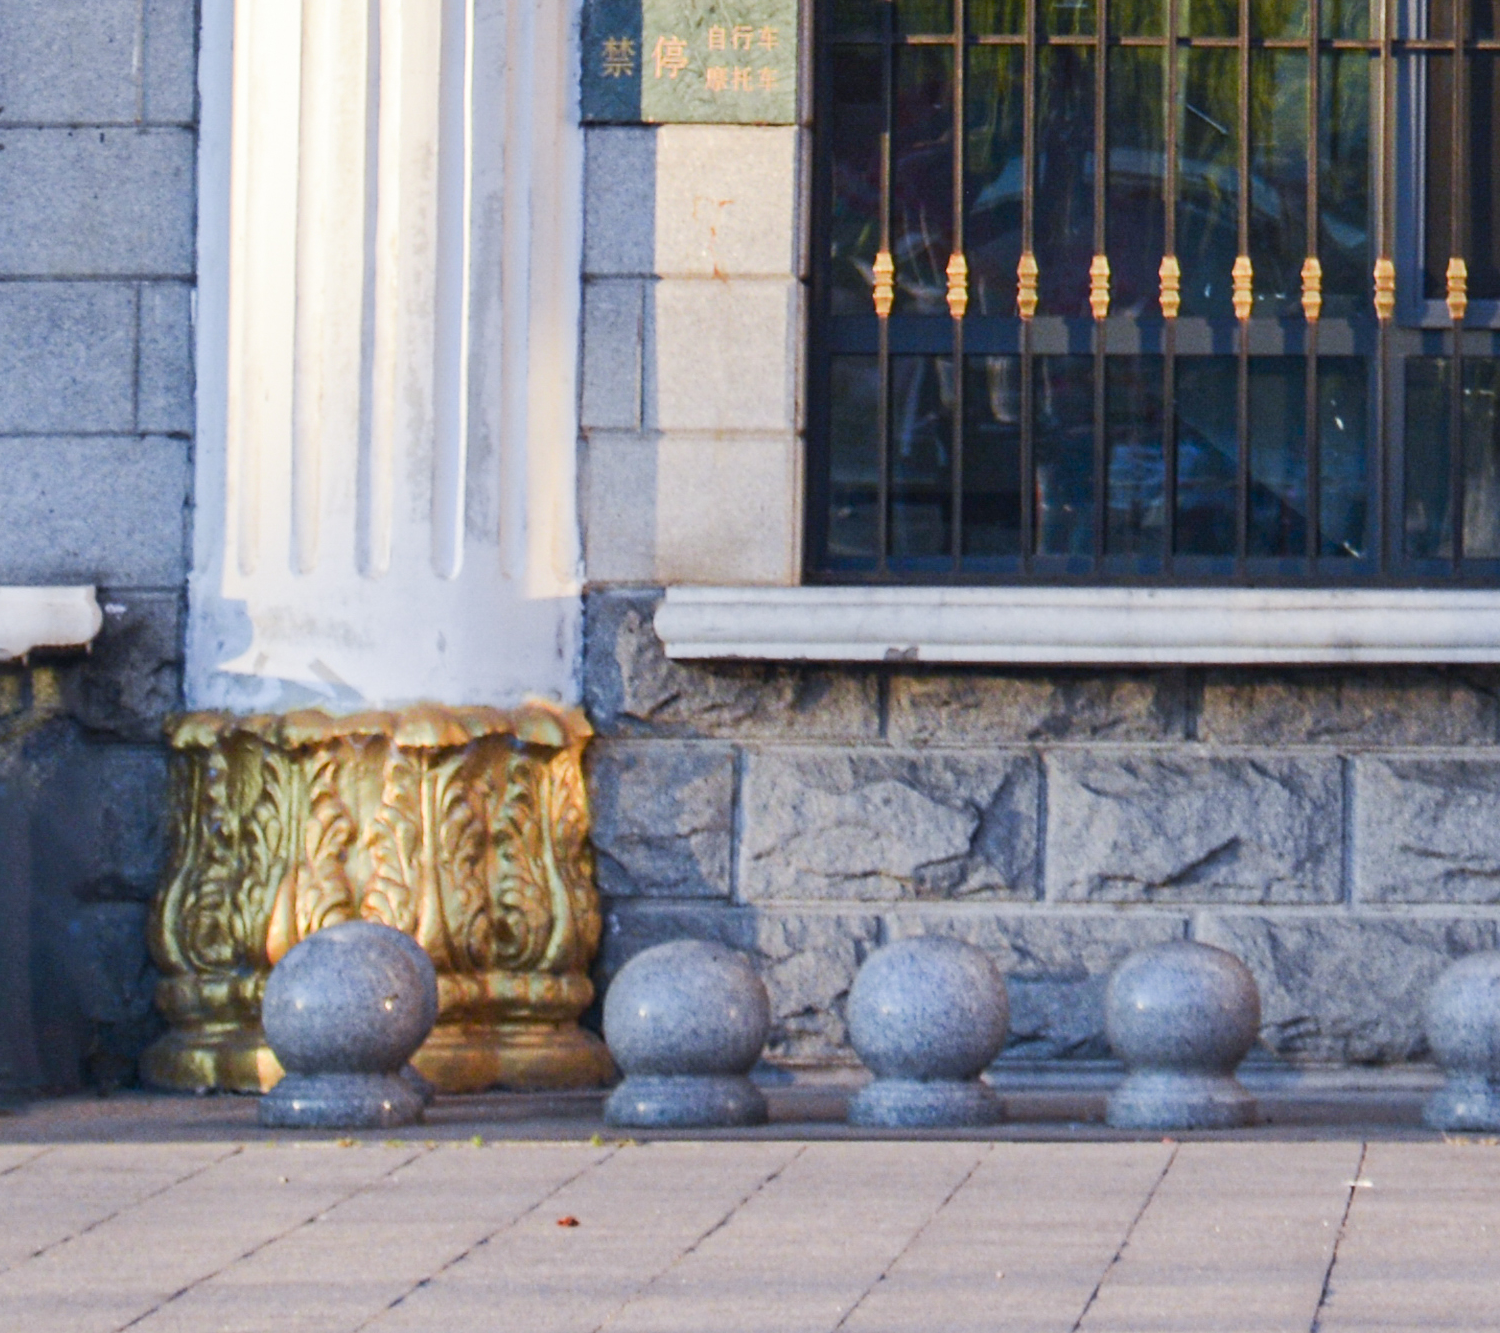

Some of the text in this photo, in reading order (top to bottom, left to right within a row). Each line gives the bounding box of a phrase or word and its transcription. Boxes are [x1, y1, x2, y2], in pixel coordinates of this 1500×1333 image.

[707, 23, 780, 52] 自行车
[705, 65, 780, 93] 摩托车
